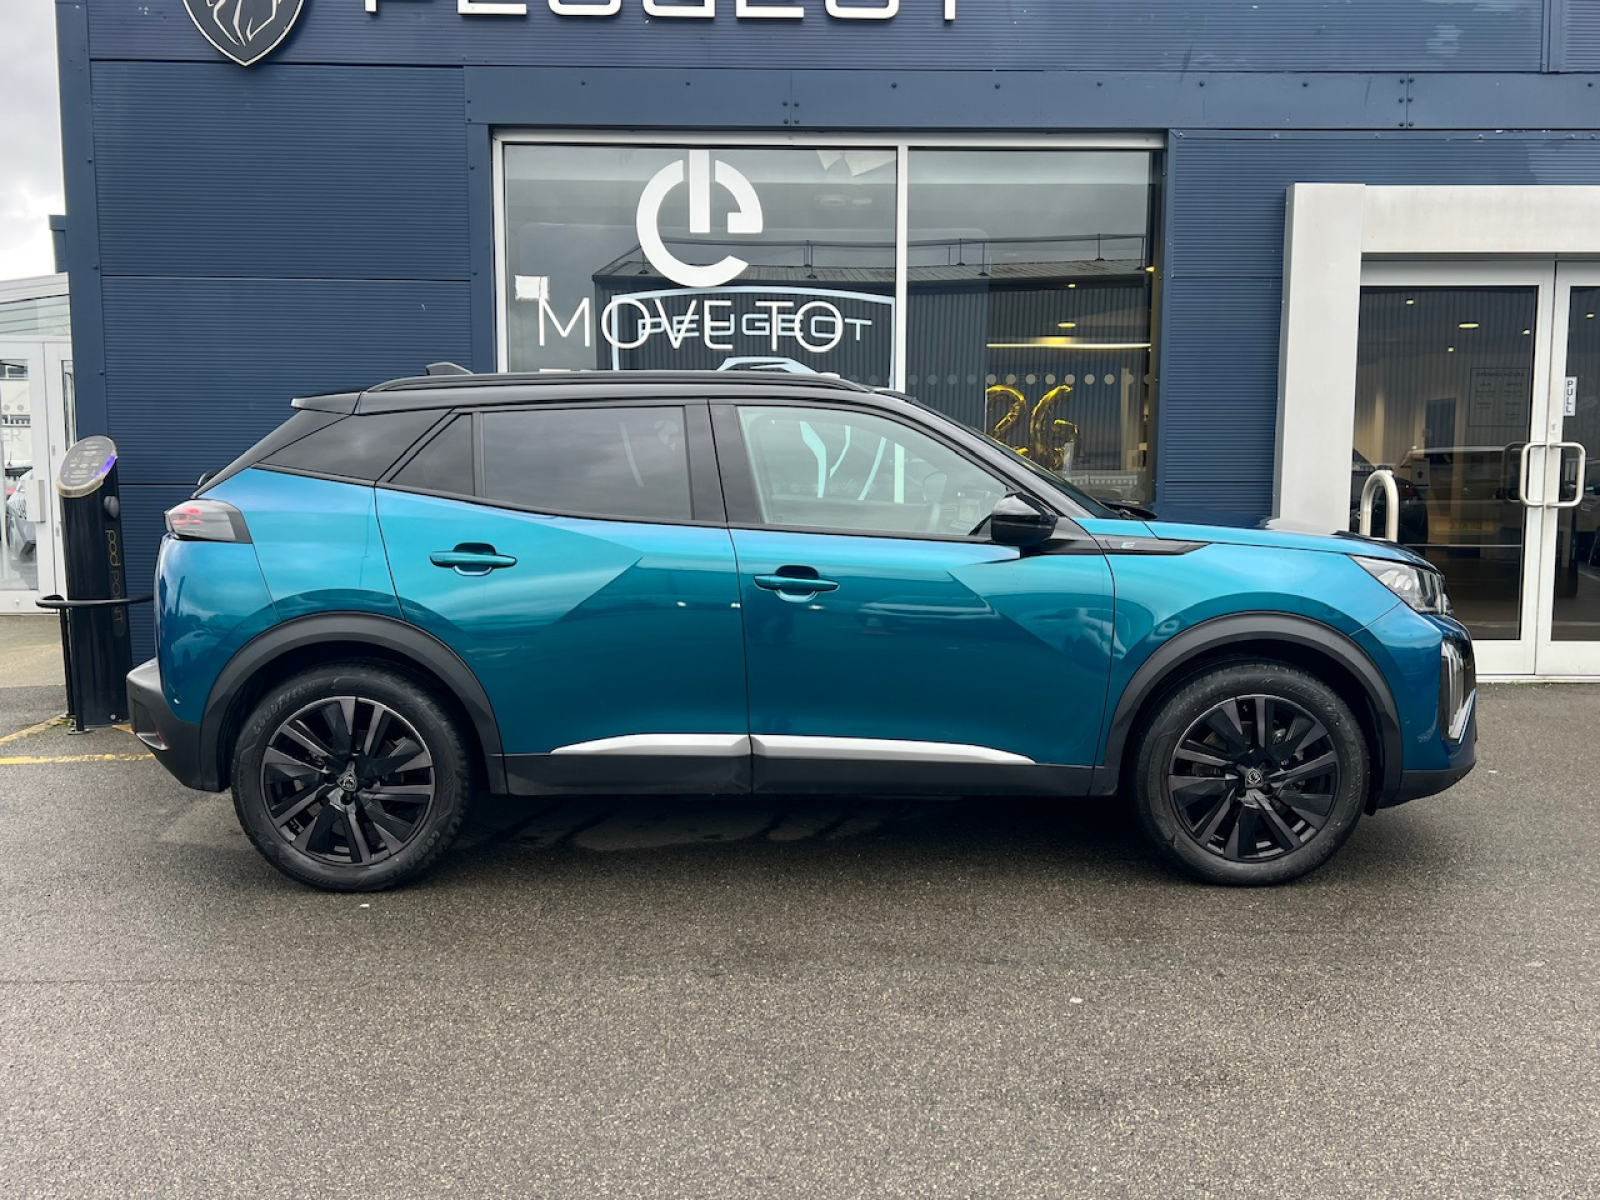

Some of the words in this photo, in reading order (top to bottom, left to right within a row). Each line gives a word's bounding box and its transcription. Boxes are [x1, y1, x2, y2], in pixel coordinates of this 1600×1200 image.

[538, 297, 734, 350] MOVE
[755, 300, 844, 353] TO
[637, 313, 873, 341] PEUGEOT
[1566, 380, 1574, 413] PULL
[105, 529, 121, 566] pod
